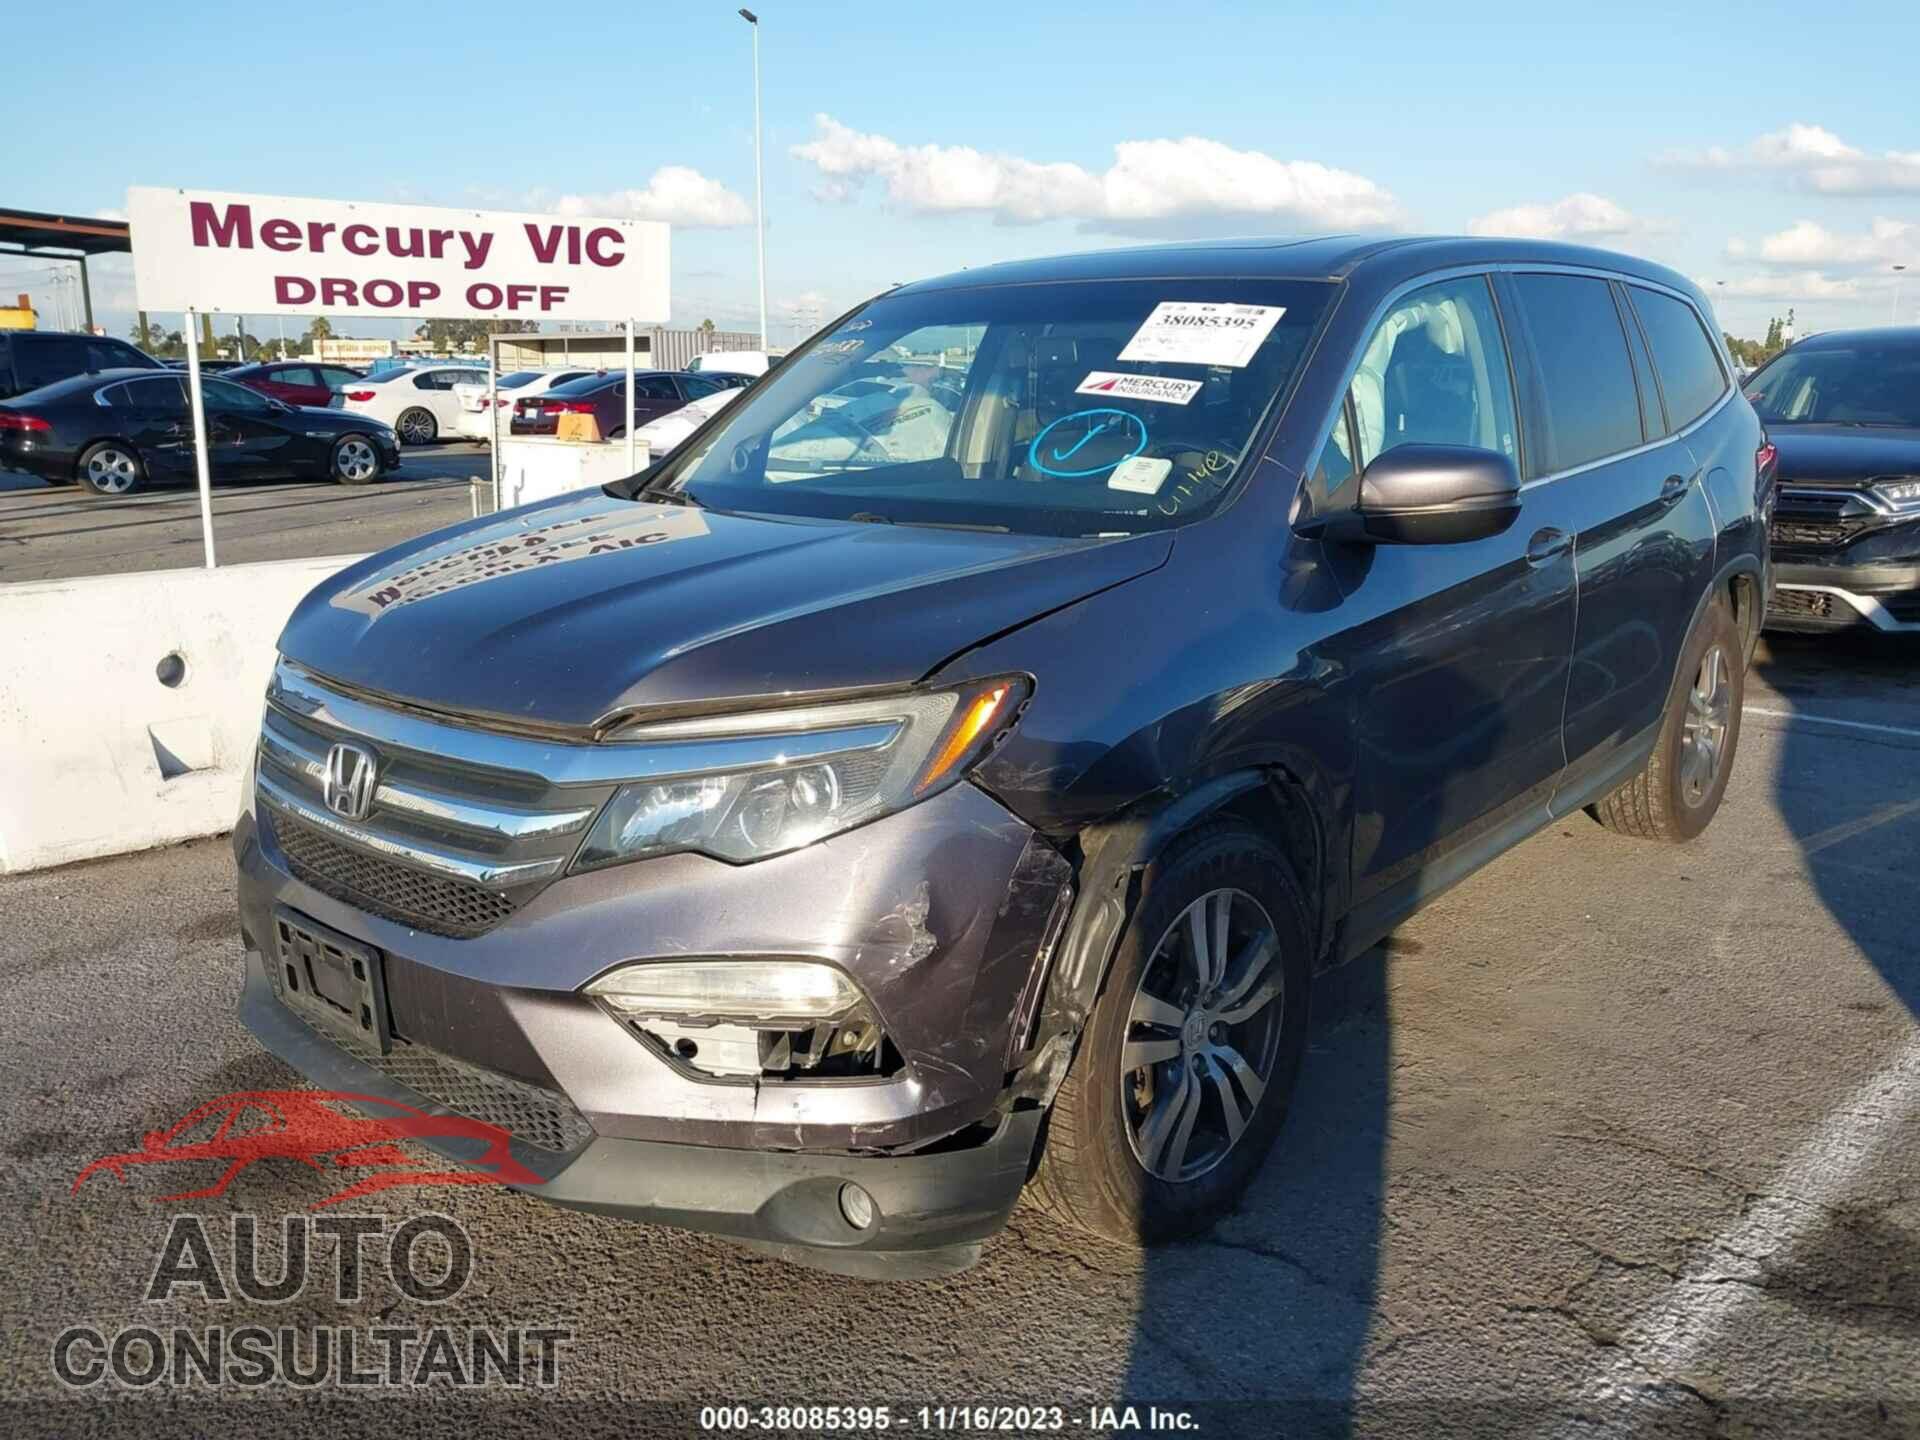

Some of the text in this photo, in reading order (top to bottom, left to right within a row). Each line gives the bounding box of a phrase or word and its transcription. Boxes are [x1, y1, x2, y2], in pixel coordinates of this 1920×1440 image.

[189, 200, 626, 270] Mercury VIC
[274, 275, 570, 312] DROP OFF
[1155, 313, 1259, 331] 38085395
[1114, 384, 1194, 402] INSURANCE
[1119, 376, 1197, 393] MERCURY
